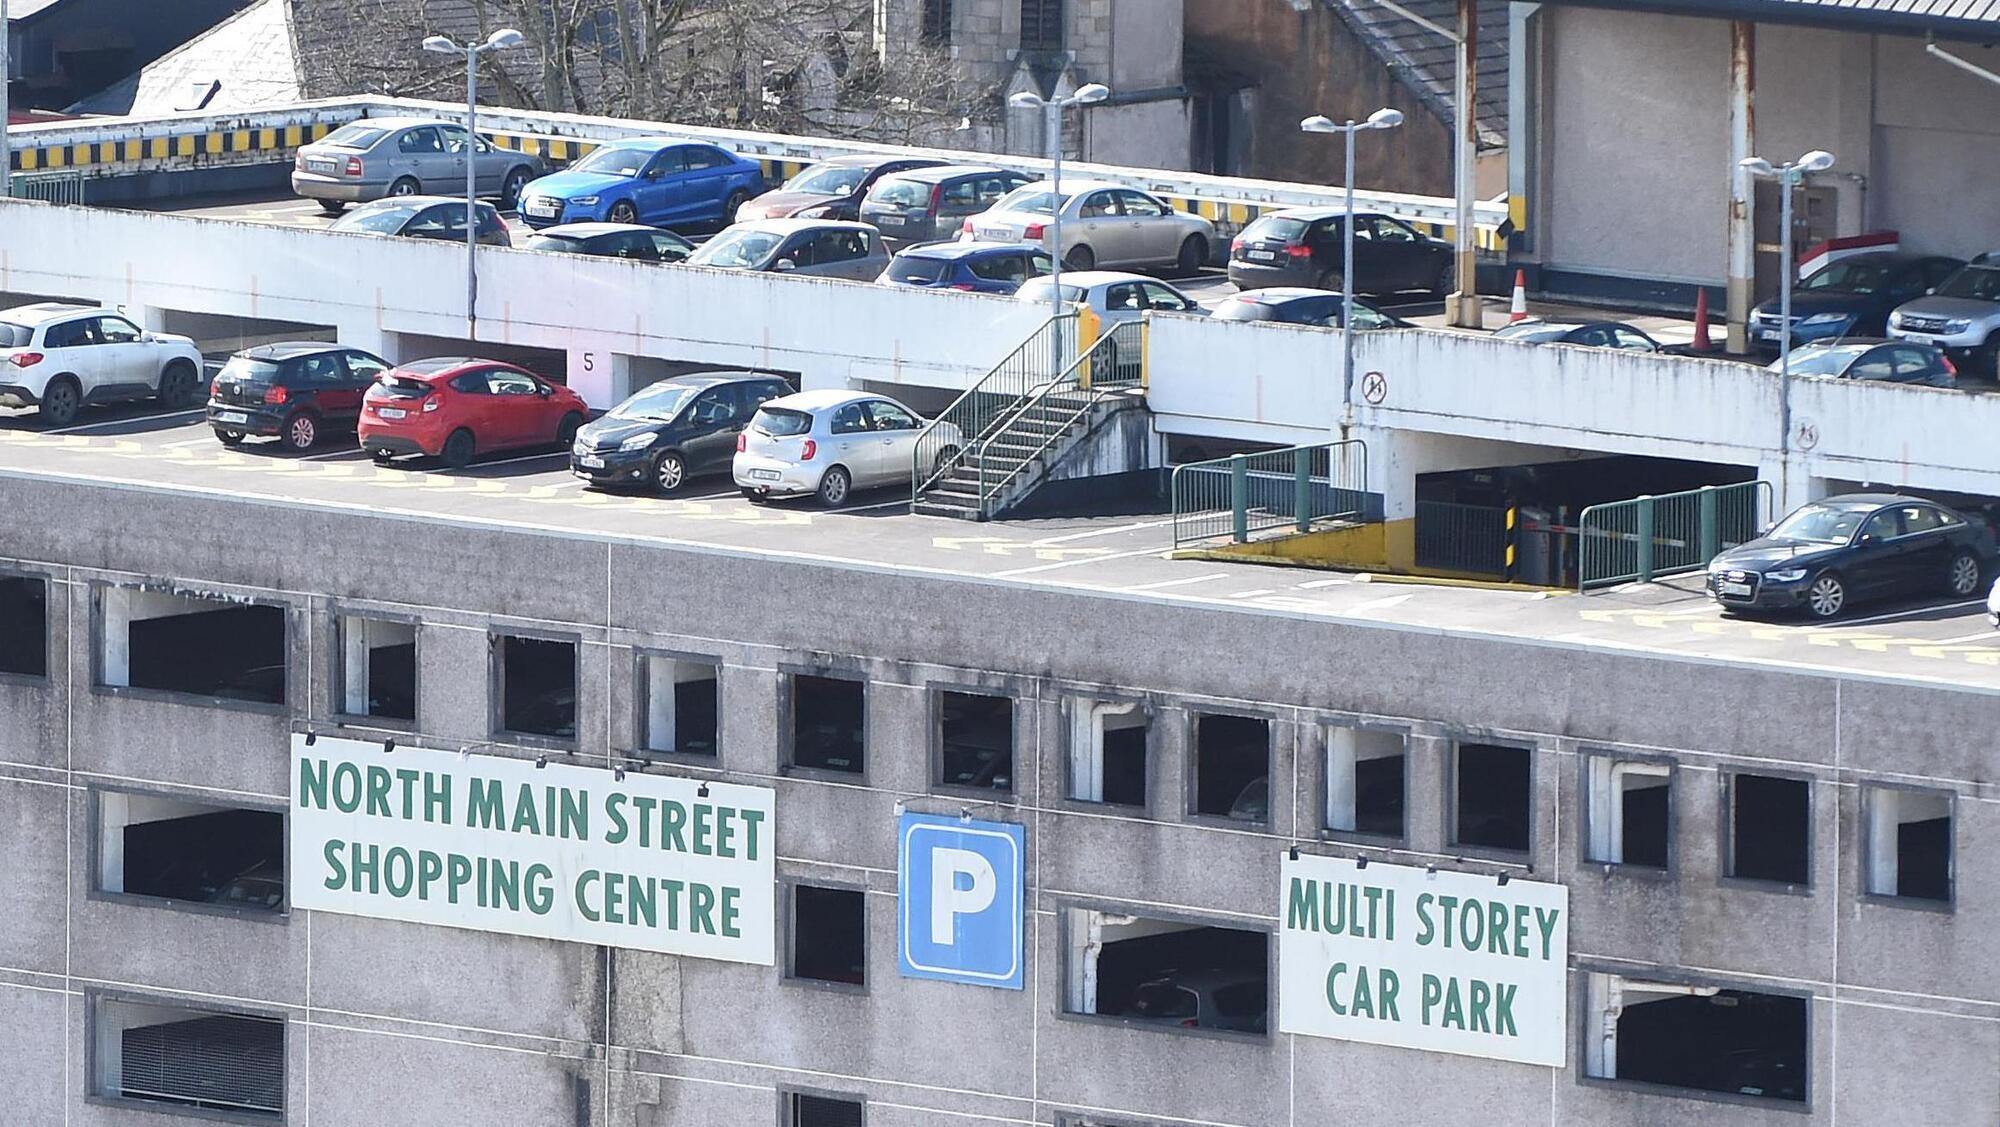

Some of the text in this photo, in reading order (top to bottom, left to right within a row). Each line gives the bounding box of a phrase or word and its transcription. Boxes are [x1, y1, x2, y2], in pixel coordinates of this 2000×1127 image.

[583, 352, 594, 372] 5
[300, 757, 765, 861] NORTH MAIN STREET
[323, 838, 741, 938] SHOPPING CENTRE
[931, 846, 996, 946] P
[1287, 877, 1559, 961] MULTI STOREY
[1326, 961, 1518, 1036] CAR PARK
